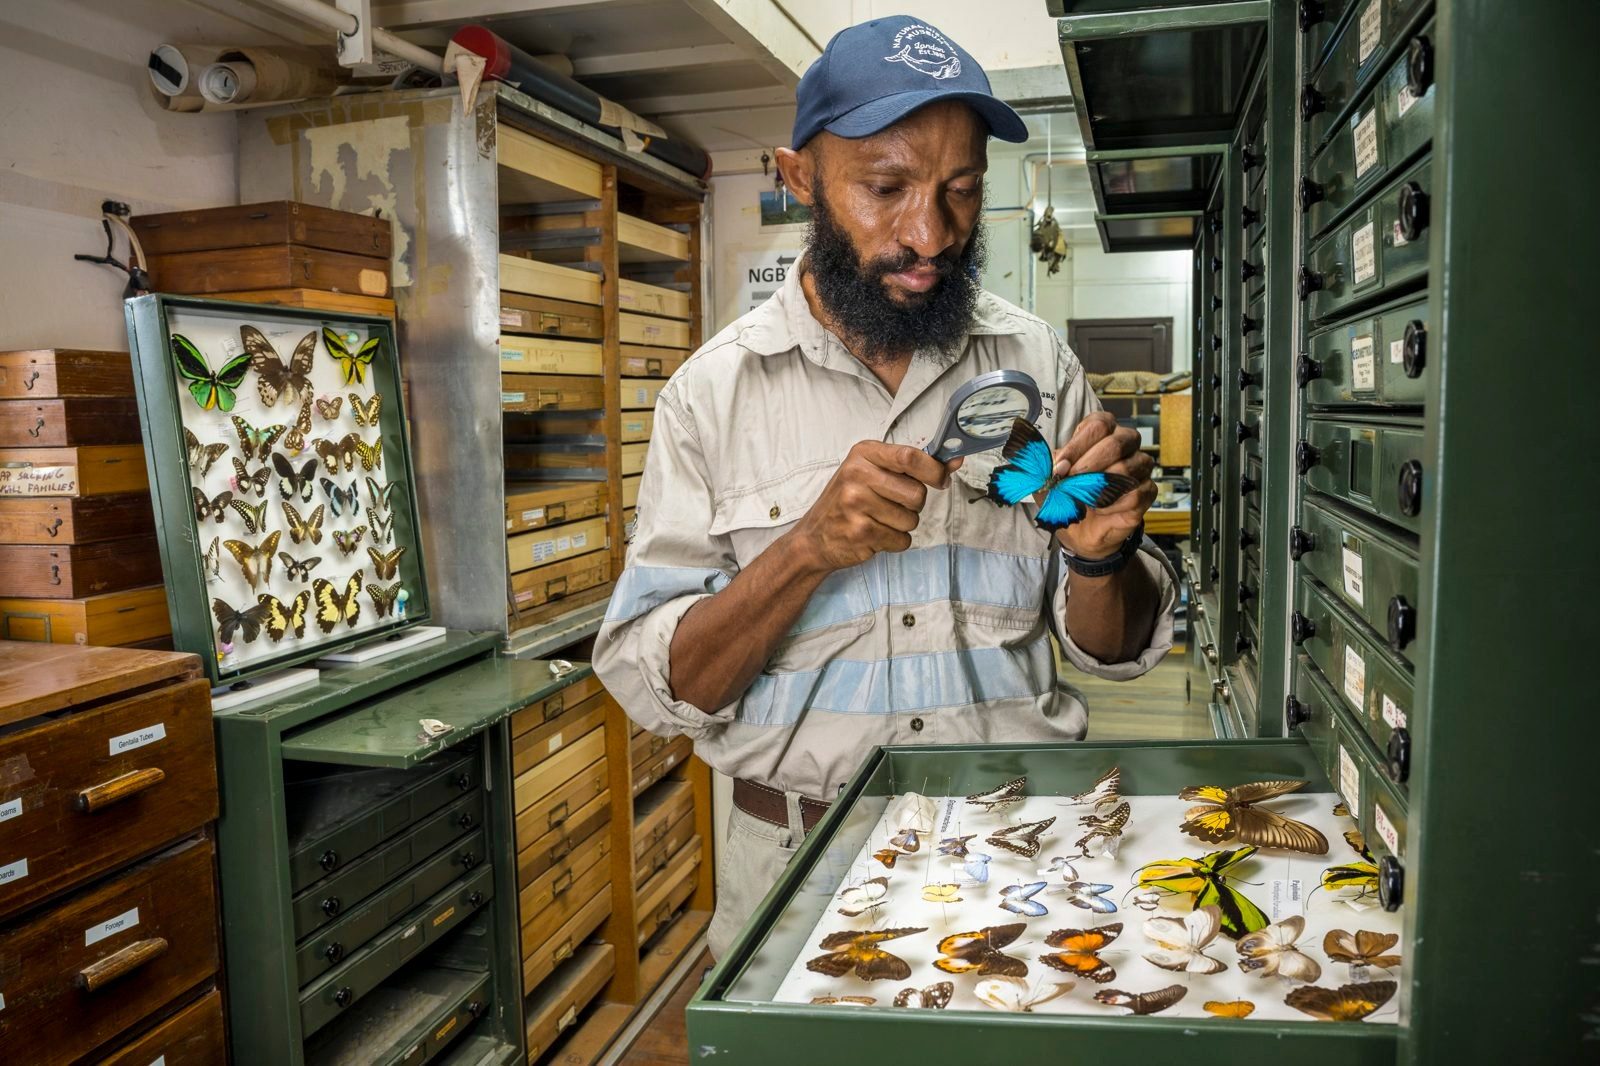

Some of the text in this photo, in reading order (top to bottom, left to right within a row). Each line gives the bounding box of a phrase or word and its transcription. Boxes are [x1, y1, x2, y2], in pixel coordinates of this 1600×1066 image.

[892, 24, 925, 48] NATURAL
[914, 41, 946, 53] London
[748, 267, 789, 283] NGB
[0, 470, 12, 481] AP
[27, 481, 75, 493] FAMILIES
[118, 732, 154, 749] Genitalia Tubes
[0, 807, 17, 817] oams
[104, 919, 124, 932] Forceps
